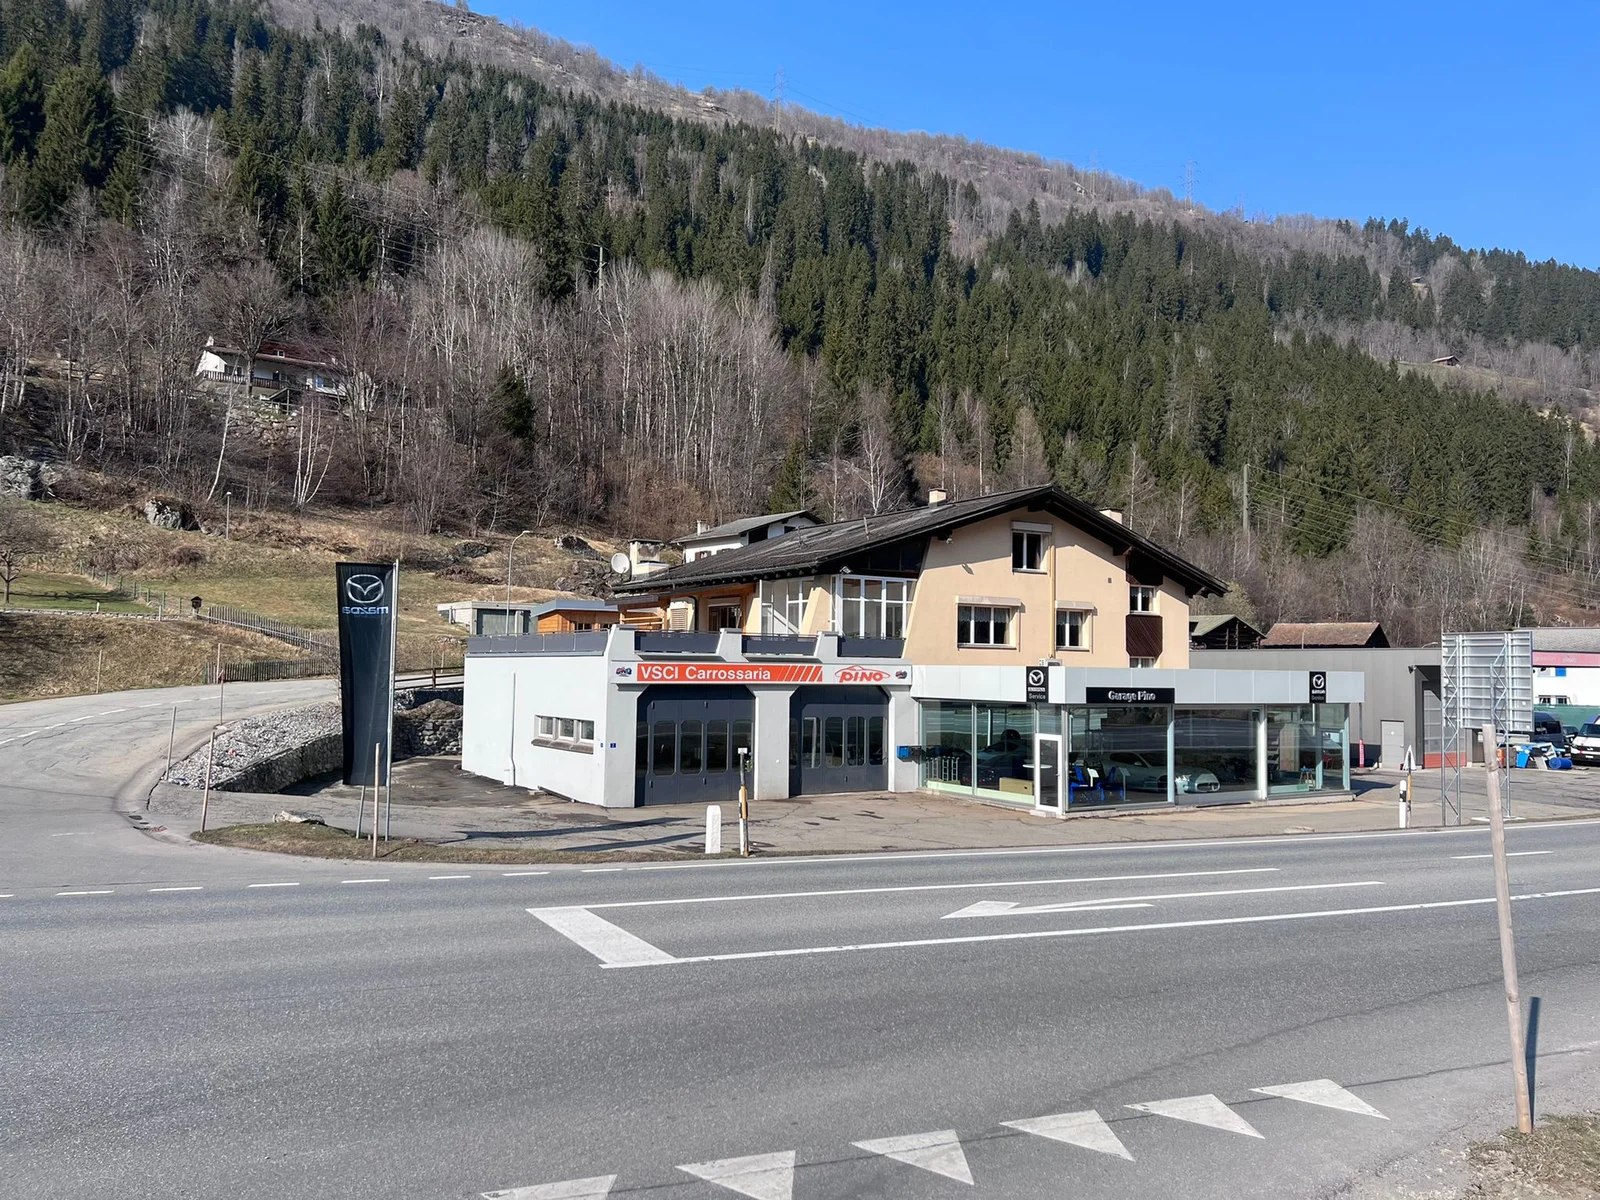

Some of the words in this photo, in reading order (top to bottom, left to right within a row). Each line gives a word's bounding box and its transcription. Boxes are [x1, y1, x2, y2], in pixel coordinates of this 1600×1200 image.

[641, 666, 678, 680] VSCI
[685, 666, 771, 680] Carrossaria
[1108, 690, 1137, 702] Garage
[1137, 690, 1156, 701] Pino
